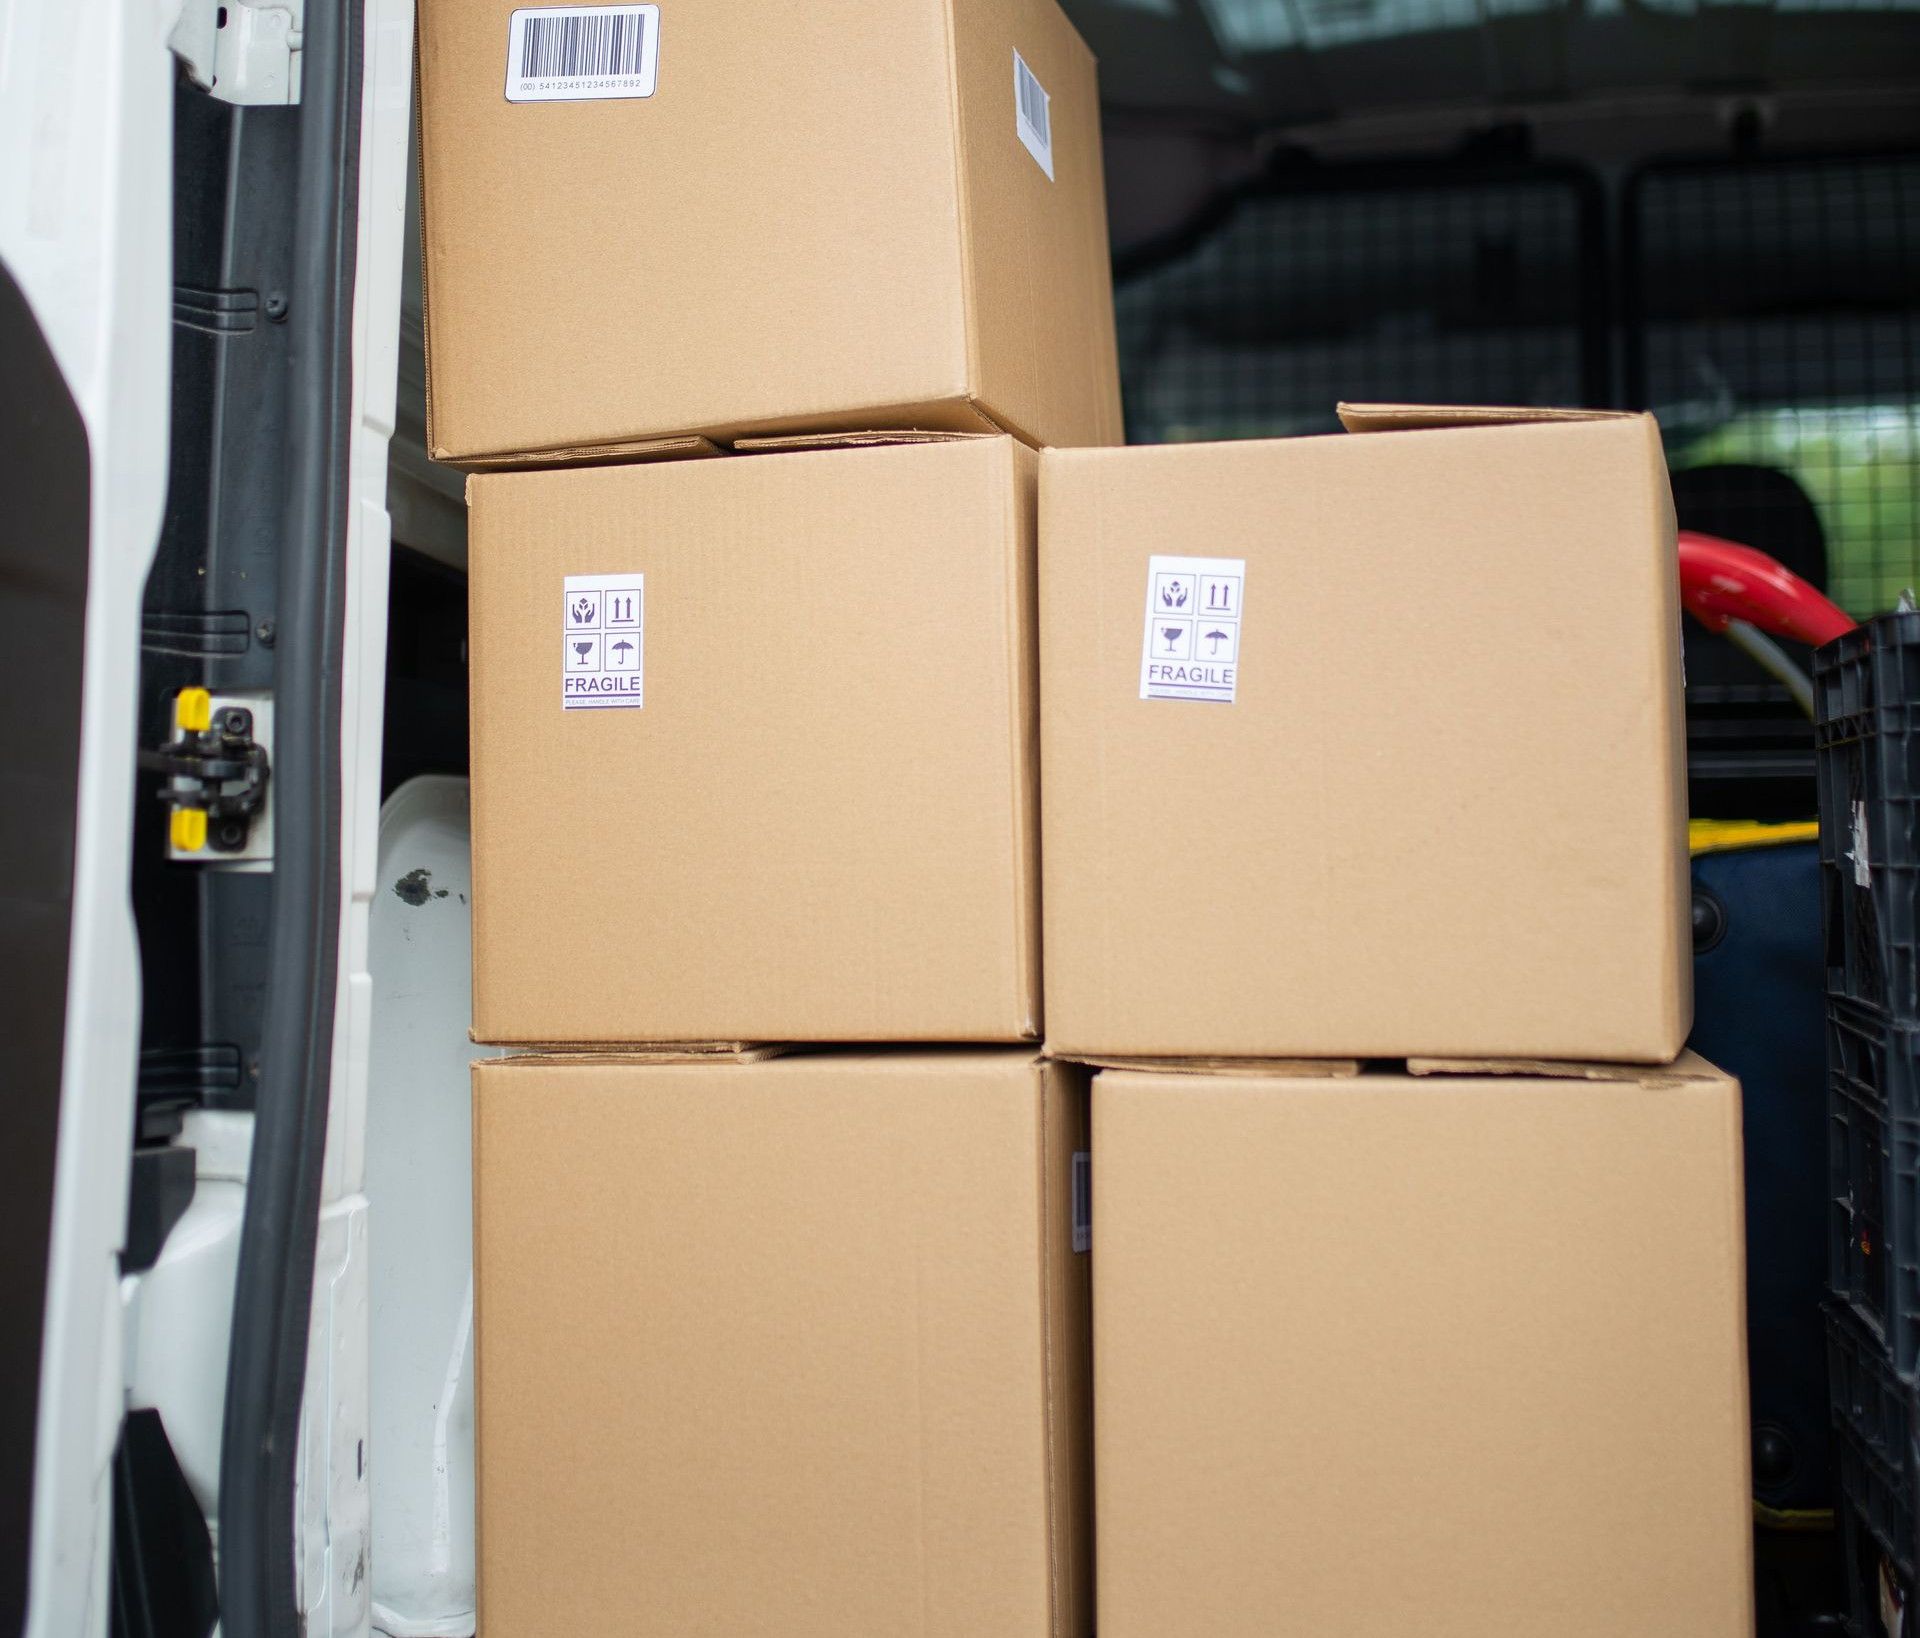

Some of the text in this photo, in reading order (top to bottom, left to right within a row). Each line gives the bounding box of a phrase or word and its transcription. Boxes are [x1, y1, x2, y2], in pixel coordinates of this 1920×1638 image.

[520, 79, 641, 91] (00) 54123451234567892
[1149, 665, 1234, 684] FRAGILE
[565, 677, 640, 692] FRAGILE
